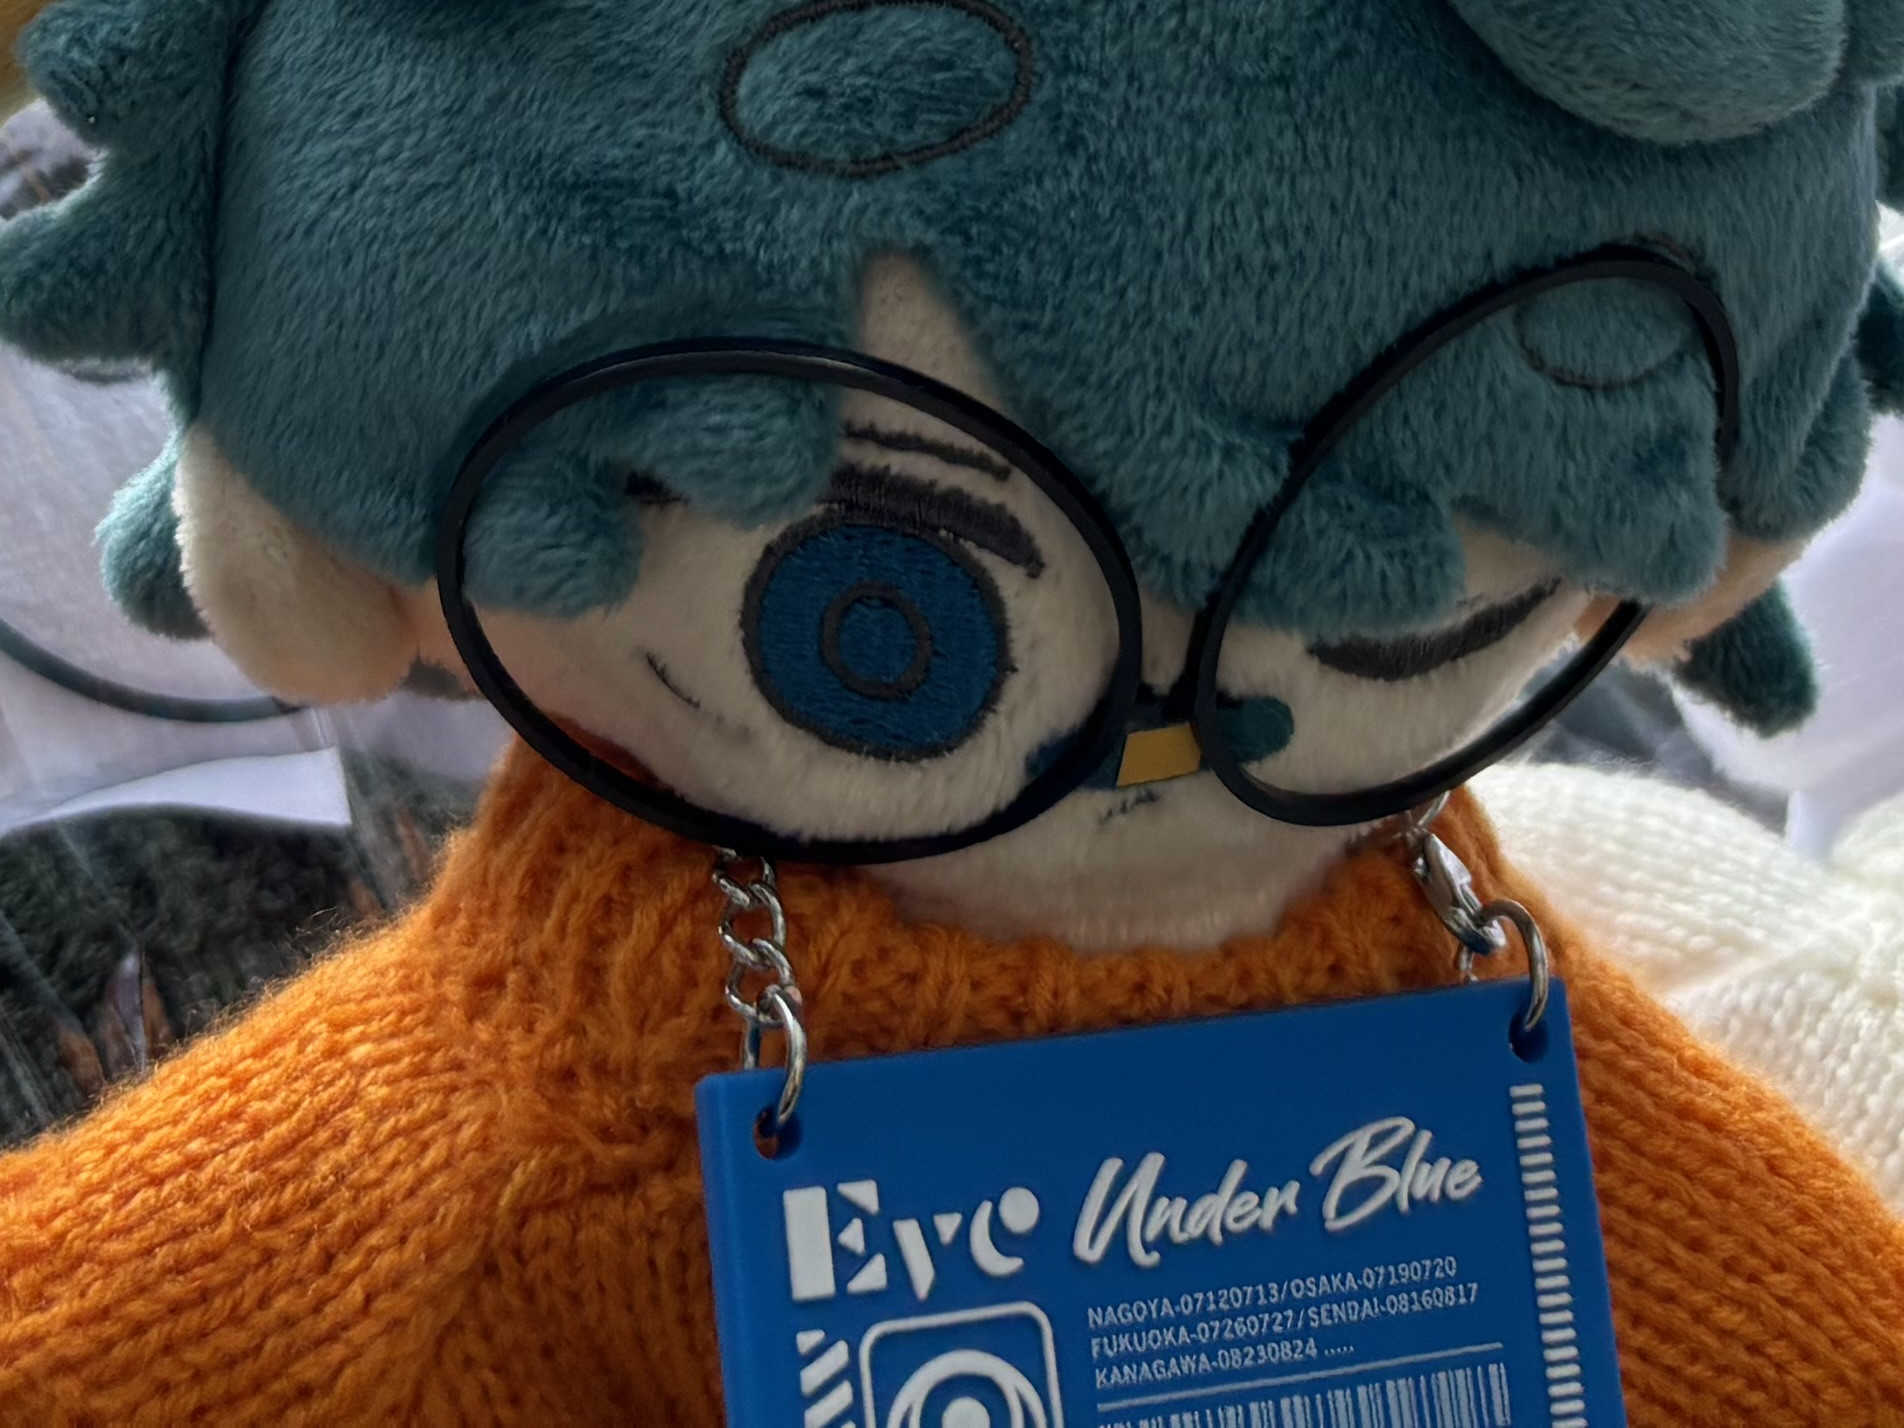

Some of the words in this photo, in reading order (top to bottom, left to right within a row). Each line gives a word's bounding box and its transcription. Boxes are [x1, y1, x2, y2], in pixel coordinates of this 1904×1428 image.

[783, 1179, 1040, 1301] Eve
[1072, 1151, 1300, 1268] Under
[1309, 1115, 1484, 1233] Blue
